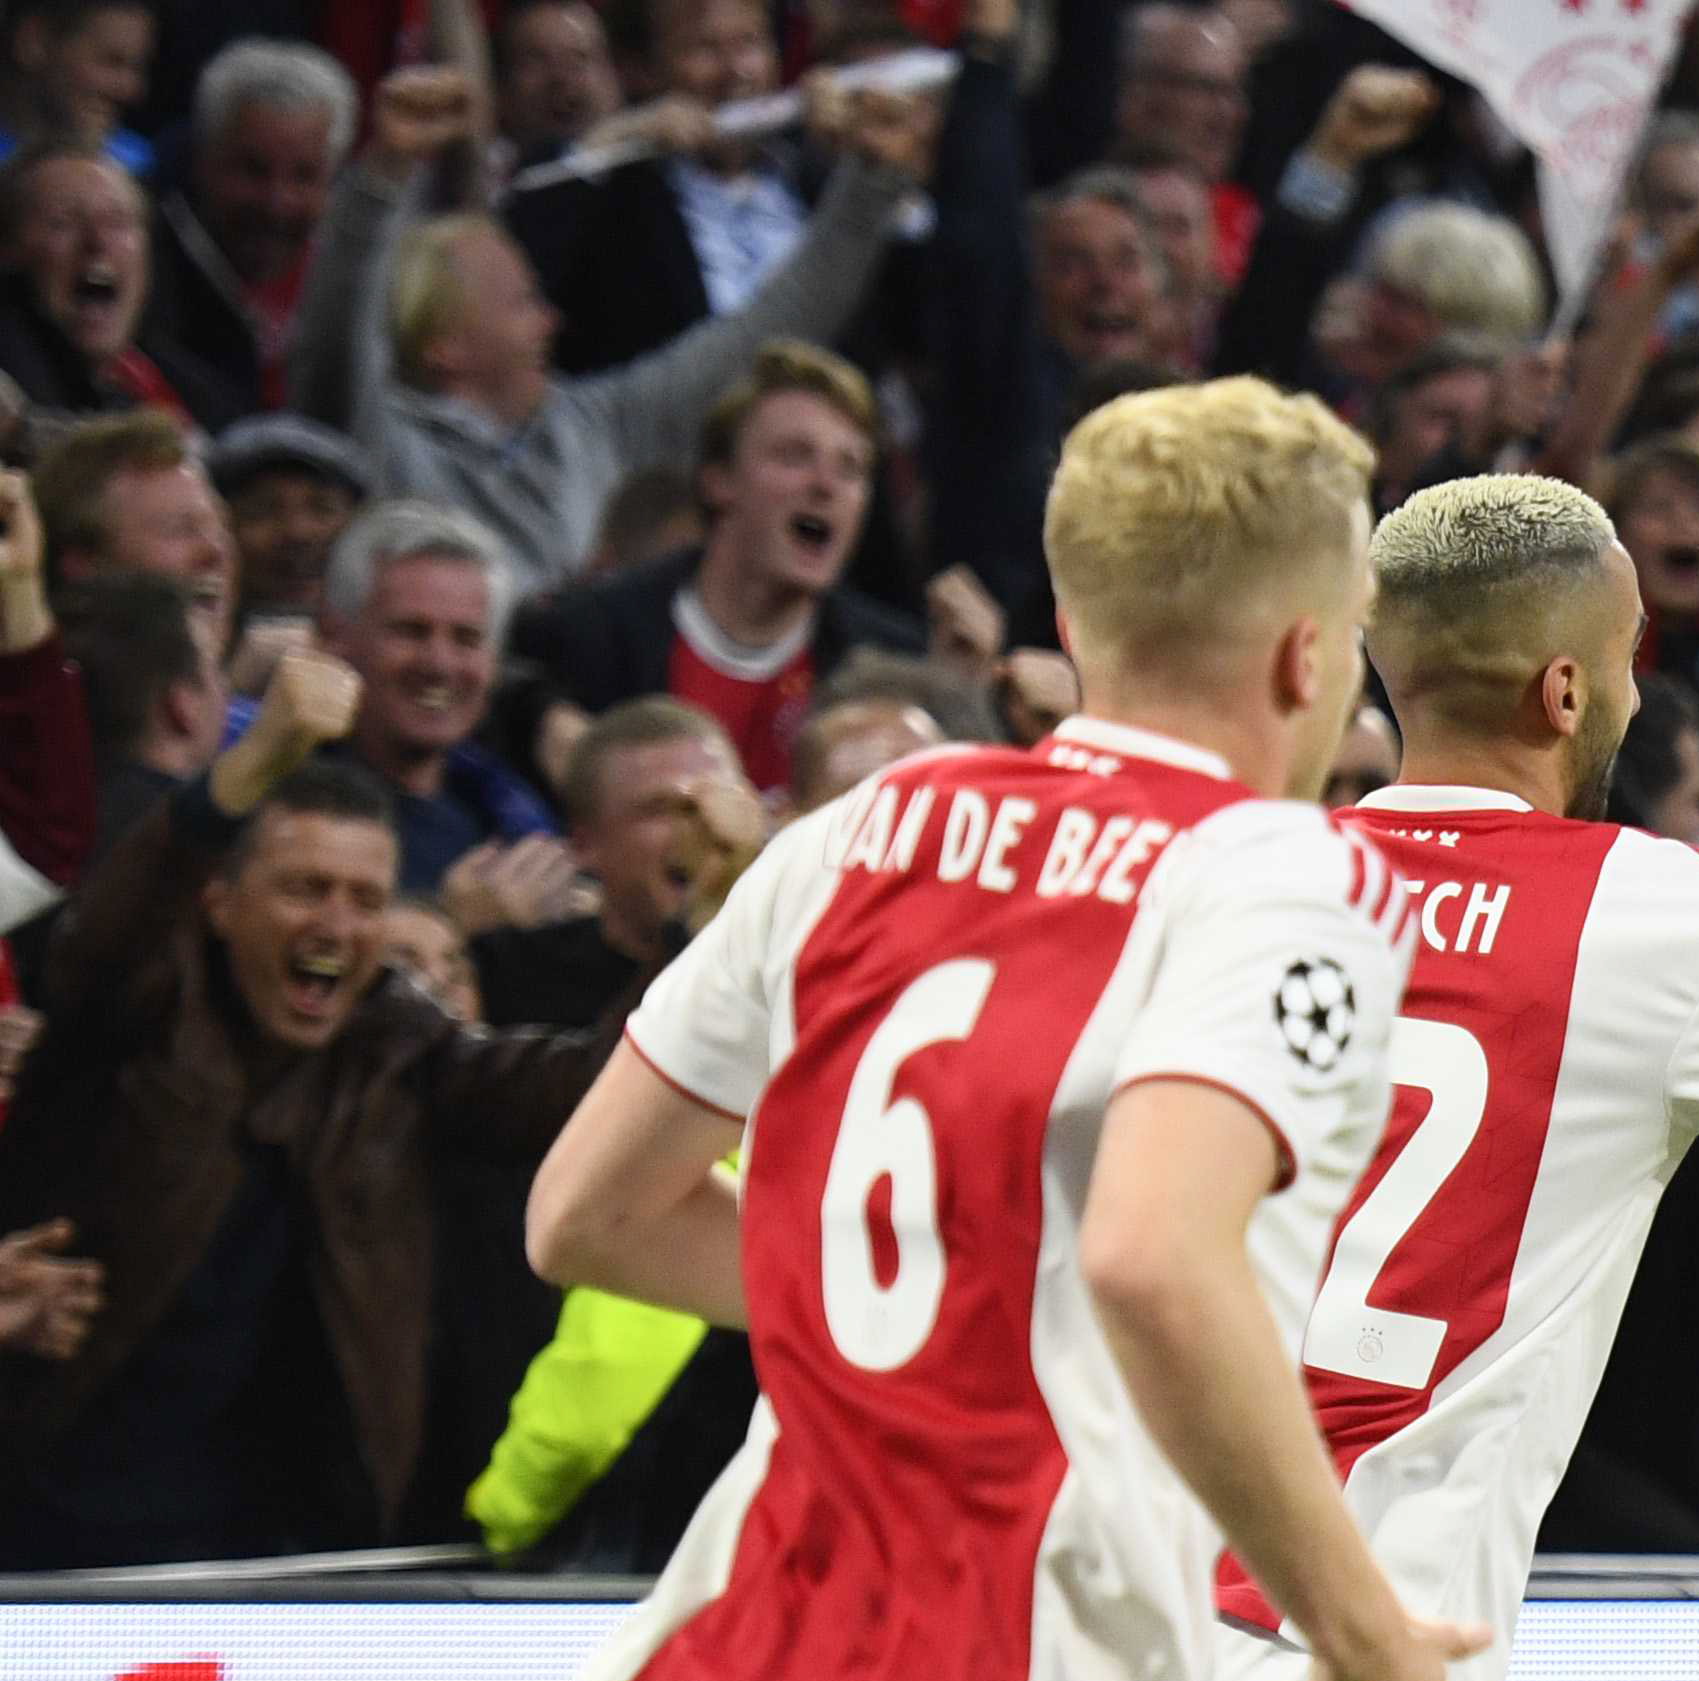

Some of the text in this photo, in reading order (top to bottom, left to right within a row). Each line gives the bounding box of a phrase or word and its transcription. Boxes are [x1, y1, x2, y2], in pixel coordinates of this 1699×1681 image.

[937, 788, 1038, 894] DE
[1035, 806, 1180, 905] BEE
[819, 957, 997, 1373] 6
